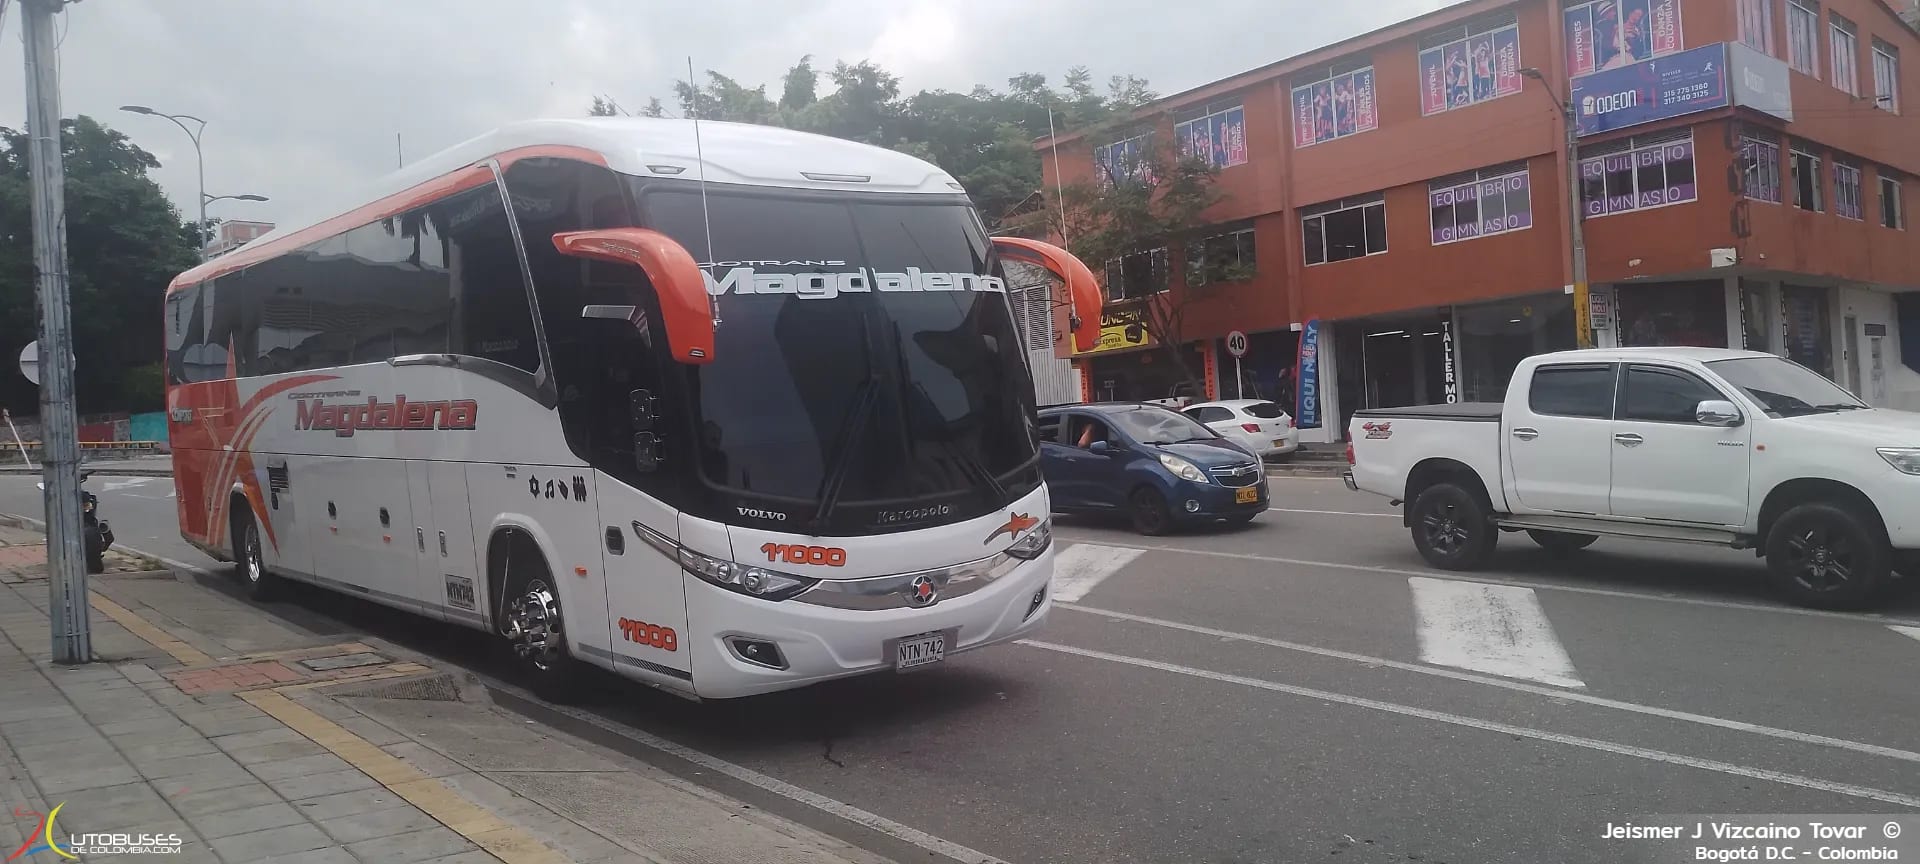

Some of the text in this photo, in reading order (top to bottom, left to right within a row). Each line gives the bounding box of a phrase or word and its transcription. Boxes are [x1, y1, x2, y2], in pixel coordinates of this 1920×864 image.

[1574, 20, 1584, 62] MAYORES
[1597, 89, 1637, 115] ODEON
[1583, 145, 1685, 177] EQUILIBRIO
[1436, 177, 1522, 207] EQUILIBRIO
[1589, 186, 1681, 214] GIMNASIO
[1441, 215, 1518, 241] GIMNASIO
[697, 259, 846, 268] OOTRANS
[700, 266, 1006, 299] Magdalena
[1230, 335, 1245, 350] 40
[1442, 322, 1454, 383] TALLER
[1304, 379, 1315, 424] LIQUI
[295, 394, 478, 438] Magdalena
[737, 507, 788, 521] VOLVO
[877, 504, 951, 524] Marcopolo
[760, 543, 847, 568] 11000
[617, 616, 678, 652] 11000
[899, 639, 943, 661] NTN 742
